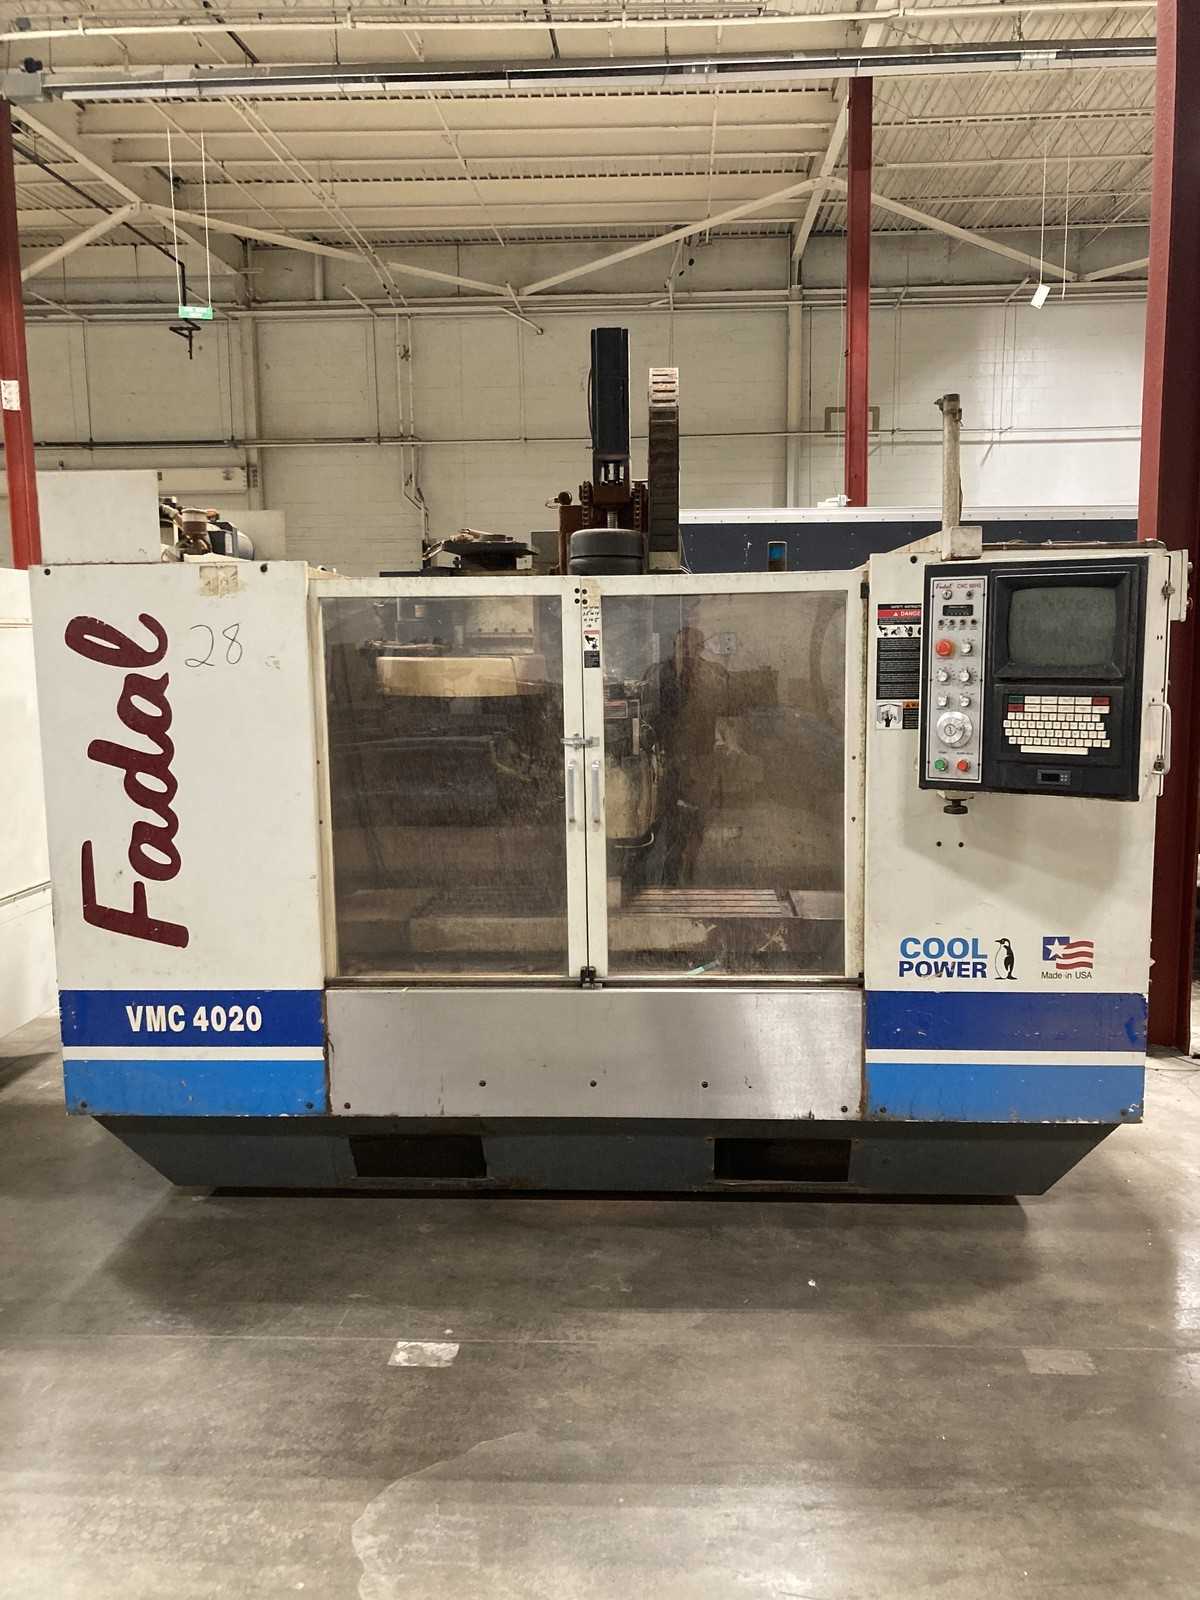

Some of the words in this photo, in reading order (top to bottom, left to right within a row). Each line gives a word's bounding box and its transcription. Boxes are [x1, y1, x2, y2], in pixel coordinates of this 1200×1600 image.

[185, 623, 243, 667] 28
[65, 613, 189, 949] Fadal
[900, 937, 988, 960] COOL
[898, 960, 988, 979] POWER
[1041, 970, 1063, 980] Made
[1065, 970, 1073, 980] in
[1075, 970, 1093, 980] USA
[126, 1005, 187, 1033] VMC
[192, 1005, 263, 1033] 4020
